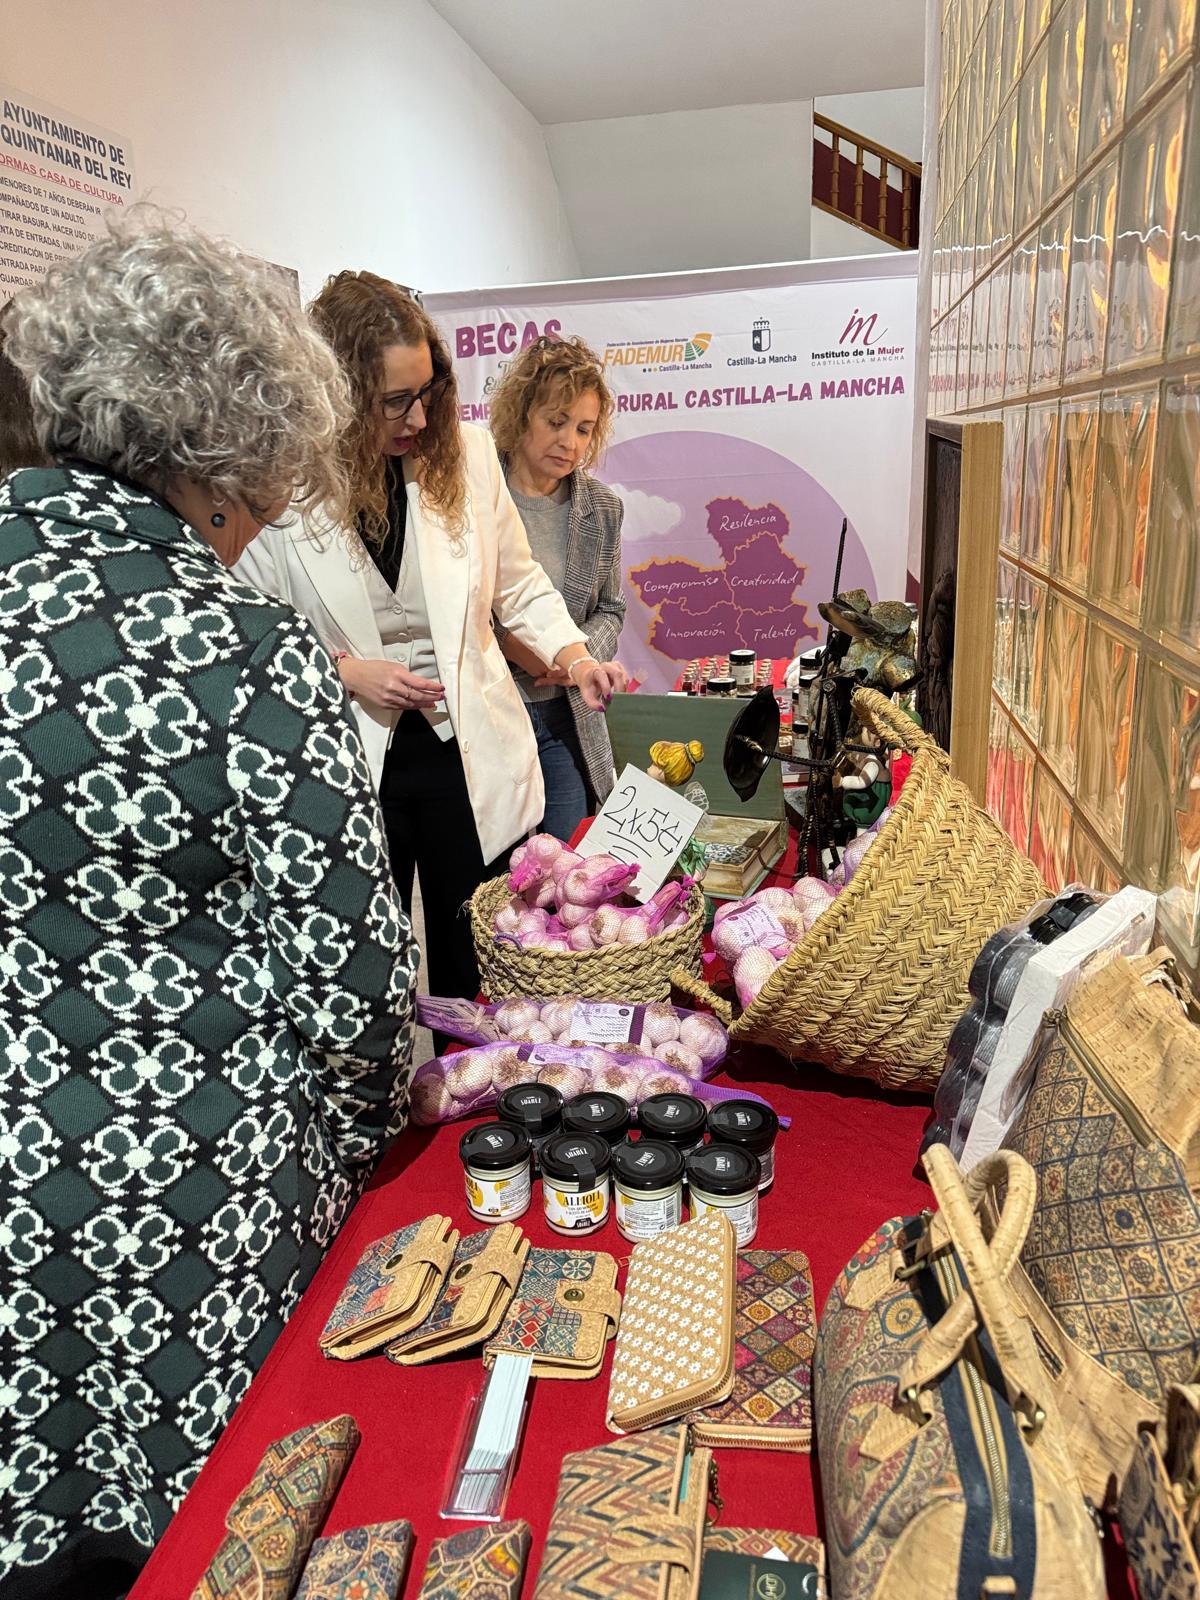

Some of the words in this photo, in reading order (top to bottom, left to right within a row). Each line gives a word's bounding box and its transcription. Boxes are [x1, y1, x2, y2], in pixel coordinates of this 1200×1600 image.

[3, 100, 107, 158] AYUNTAMIENTO
[109, 143, 125, 166] DE
[0, 124, 83, 171] QUINTANAR
[84, 155, 108, 181] DEL
[110, 167, 132, 190] REY
[33, 186, 42, 198] DE
[43, 189, 47, 198] 7
[48, 191, 66, 204] AÑOS
[39, 167, 67, 187] CASA
[69, 178, 82, 190] DE
[84, 183, 124, 206] CULTURA
[41, 203, 50, 214] DE
[51, 206, 60, 217] UN
[0, 208, 21, 223] TIRAR
[53, 224, 73, 237] HACER
[74, 230, 87, 241] USO
[15, 228, 25, 239] DE
[63, 241, 76, 251] UNA
[45, 251, 54, 261] DE
[455, 319, 562, 359] BECAS
[603, 344, 685, 367] FADEMUR
[727, 356, 766, 367] Castilla-La
[768, 353, 797, 364] Mancha
[811, 350, 850, 360] Instituto
[852, 348, 864, 357] de
[866, 348, 875, 356] la
[877, 346, 904, 356] Mujer
[811, 358, 866, 367] CASTILLA-LA
[870, 355, 905, 363] MANCHA
[659, 364, 689, 372] Castilla-La
[690, 362, 712, 370] Mancha
[617, 392, 679, 413] RURAL
[684, 382, 813, 409] CASTILLA-LA
[820, 376, 905, 400] MANCHA
[644, 574, 719, 594] Compromiso
[730, 571, 799, 588] Creatividad
[665, 622, 727, 638] Innovación
[753, 623, 797, 642] Talento
